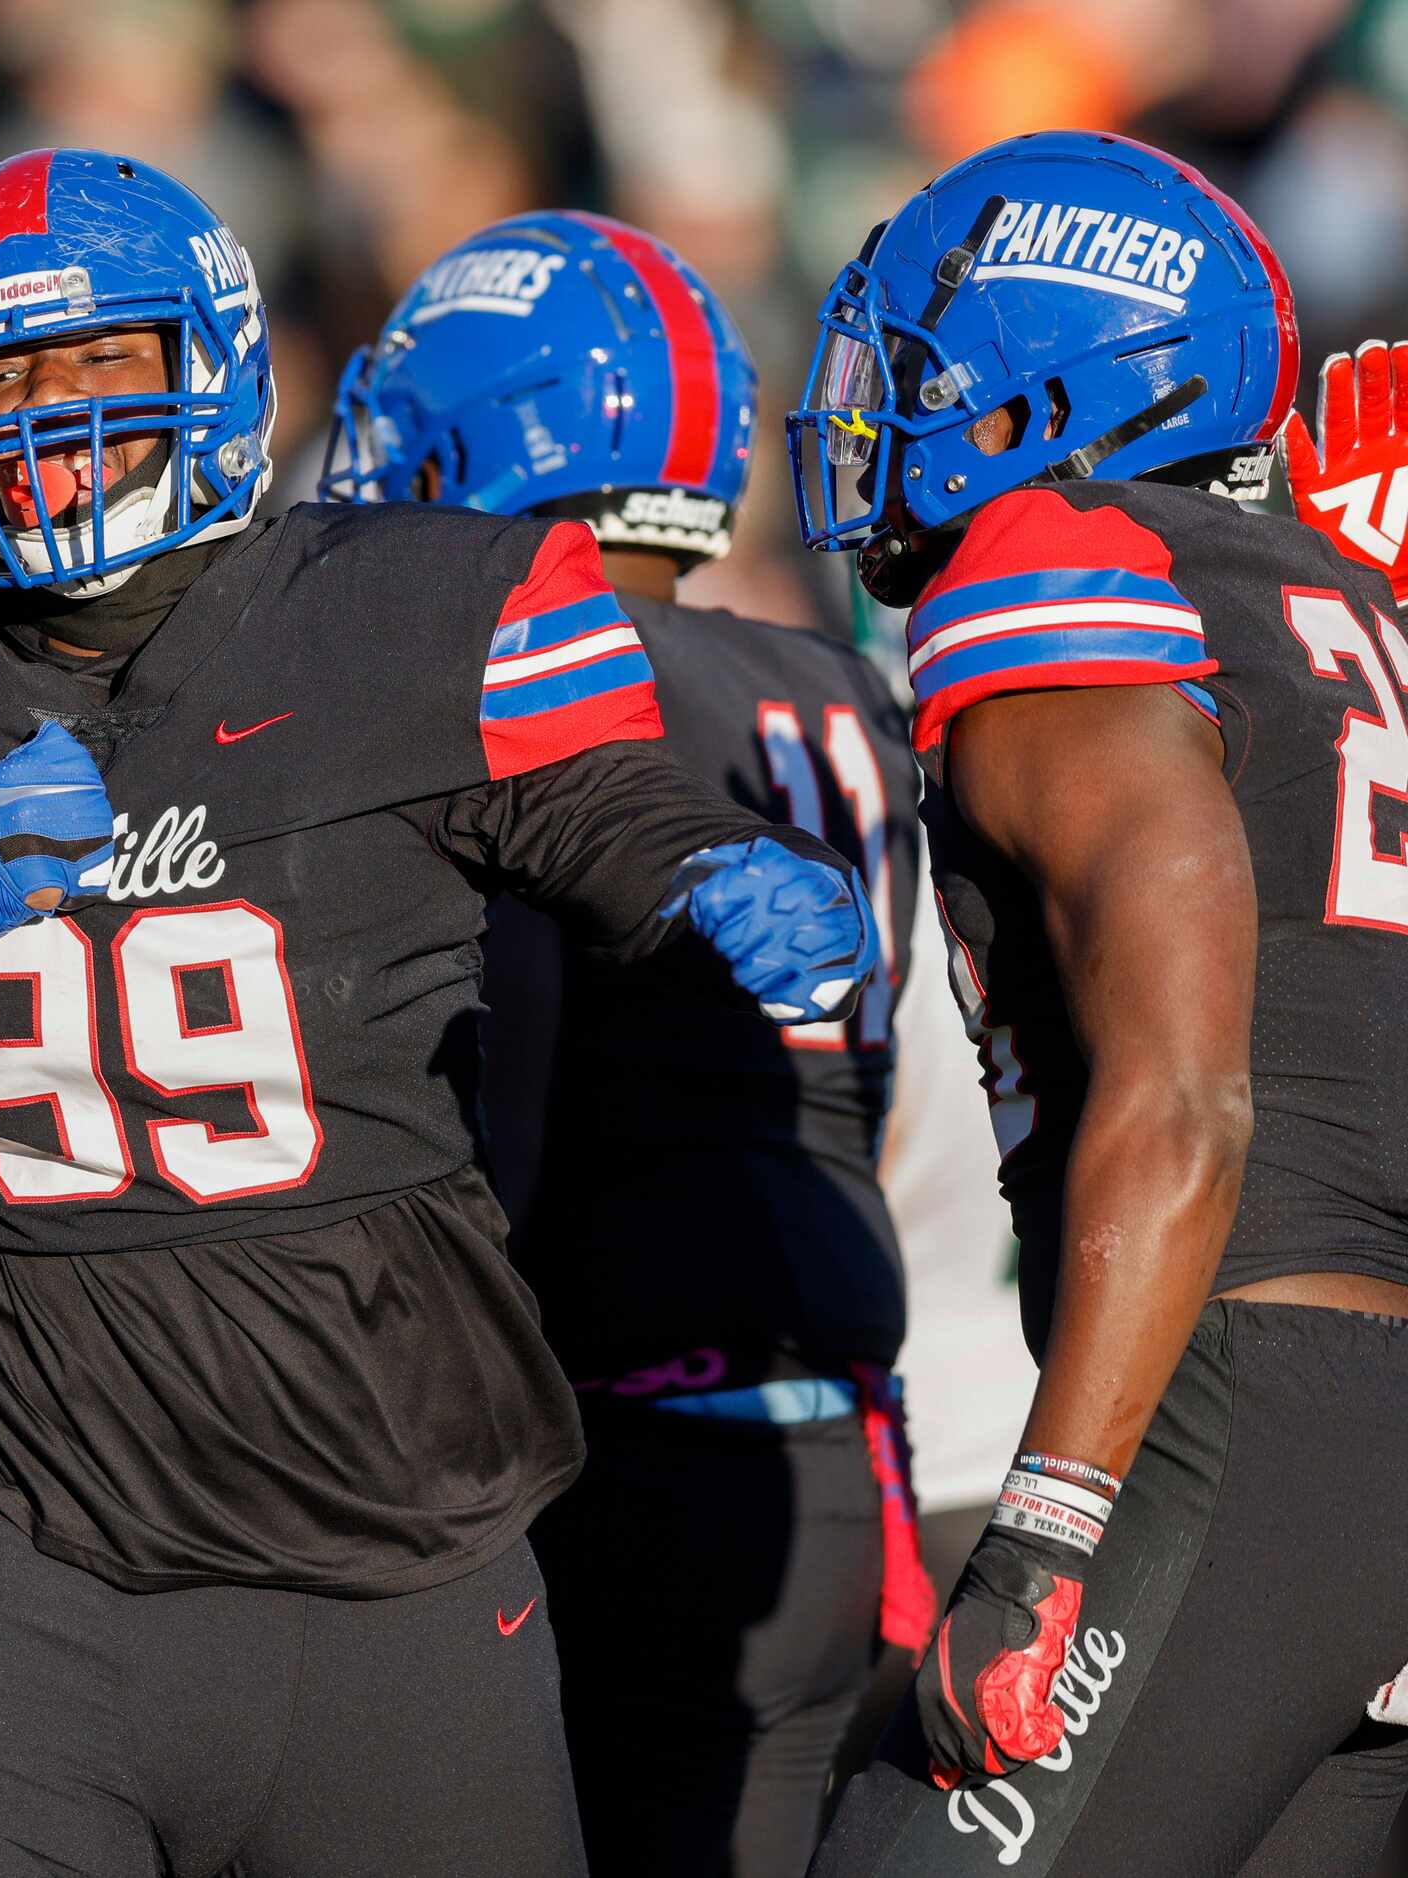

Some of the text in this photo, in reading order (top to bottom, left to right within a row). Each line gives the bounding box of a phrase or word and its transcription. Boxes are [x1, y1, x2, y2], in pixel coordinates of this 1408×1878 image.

[980, 202, 1205, 295] PANTHERS
[1161, 412, 1191, 432] LARGE
[1281, 585, 1408, 936] 2
[106, 804, 226, 902] ille
[1023, 1496, 1043, 1512] FOR
[1044, 1503, 1066, 1521] THE
[1033, 1518, 1069, 1537] TEXAS
